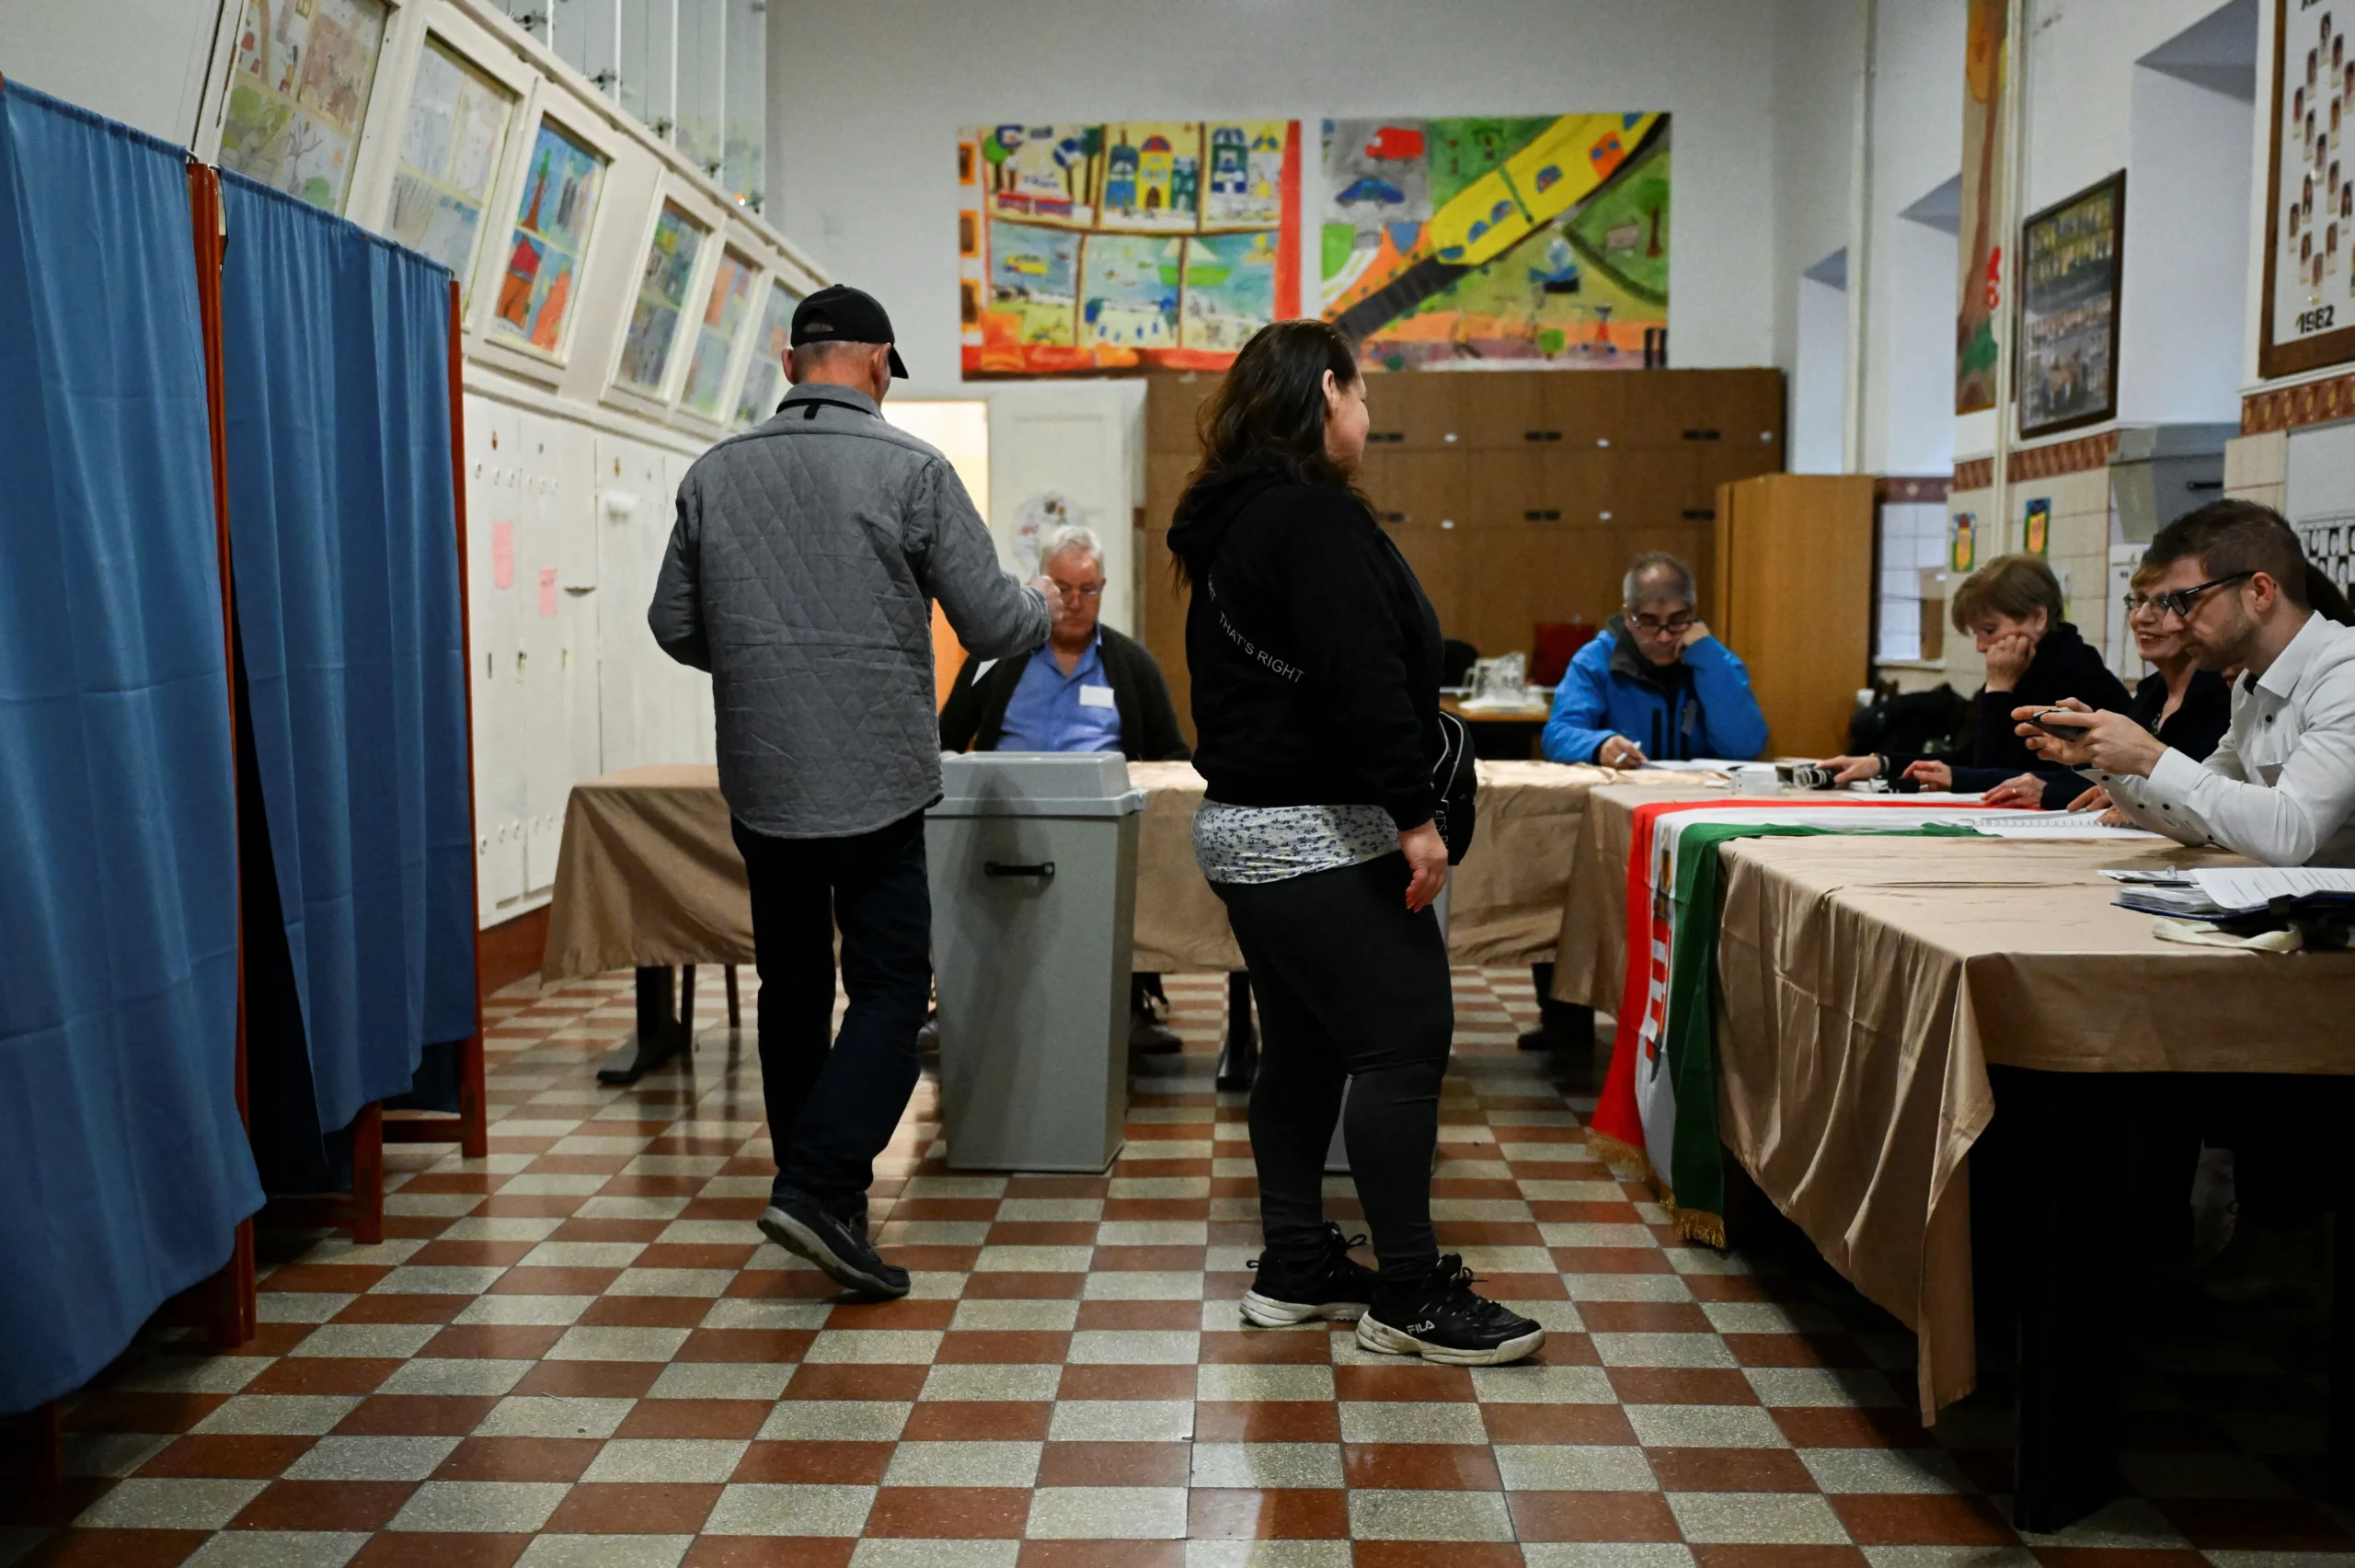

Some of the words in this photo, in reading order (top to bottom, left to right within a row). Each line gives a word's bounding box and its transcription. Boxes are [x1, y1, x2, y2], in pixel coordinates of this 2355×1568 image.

[1219, 611, 1255, 656] THAT'S
[1257, 650, 1305, 682] RIGHT
[1406, 1320, 1436, 1335] FILA
